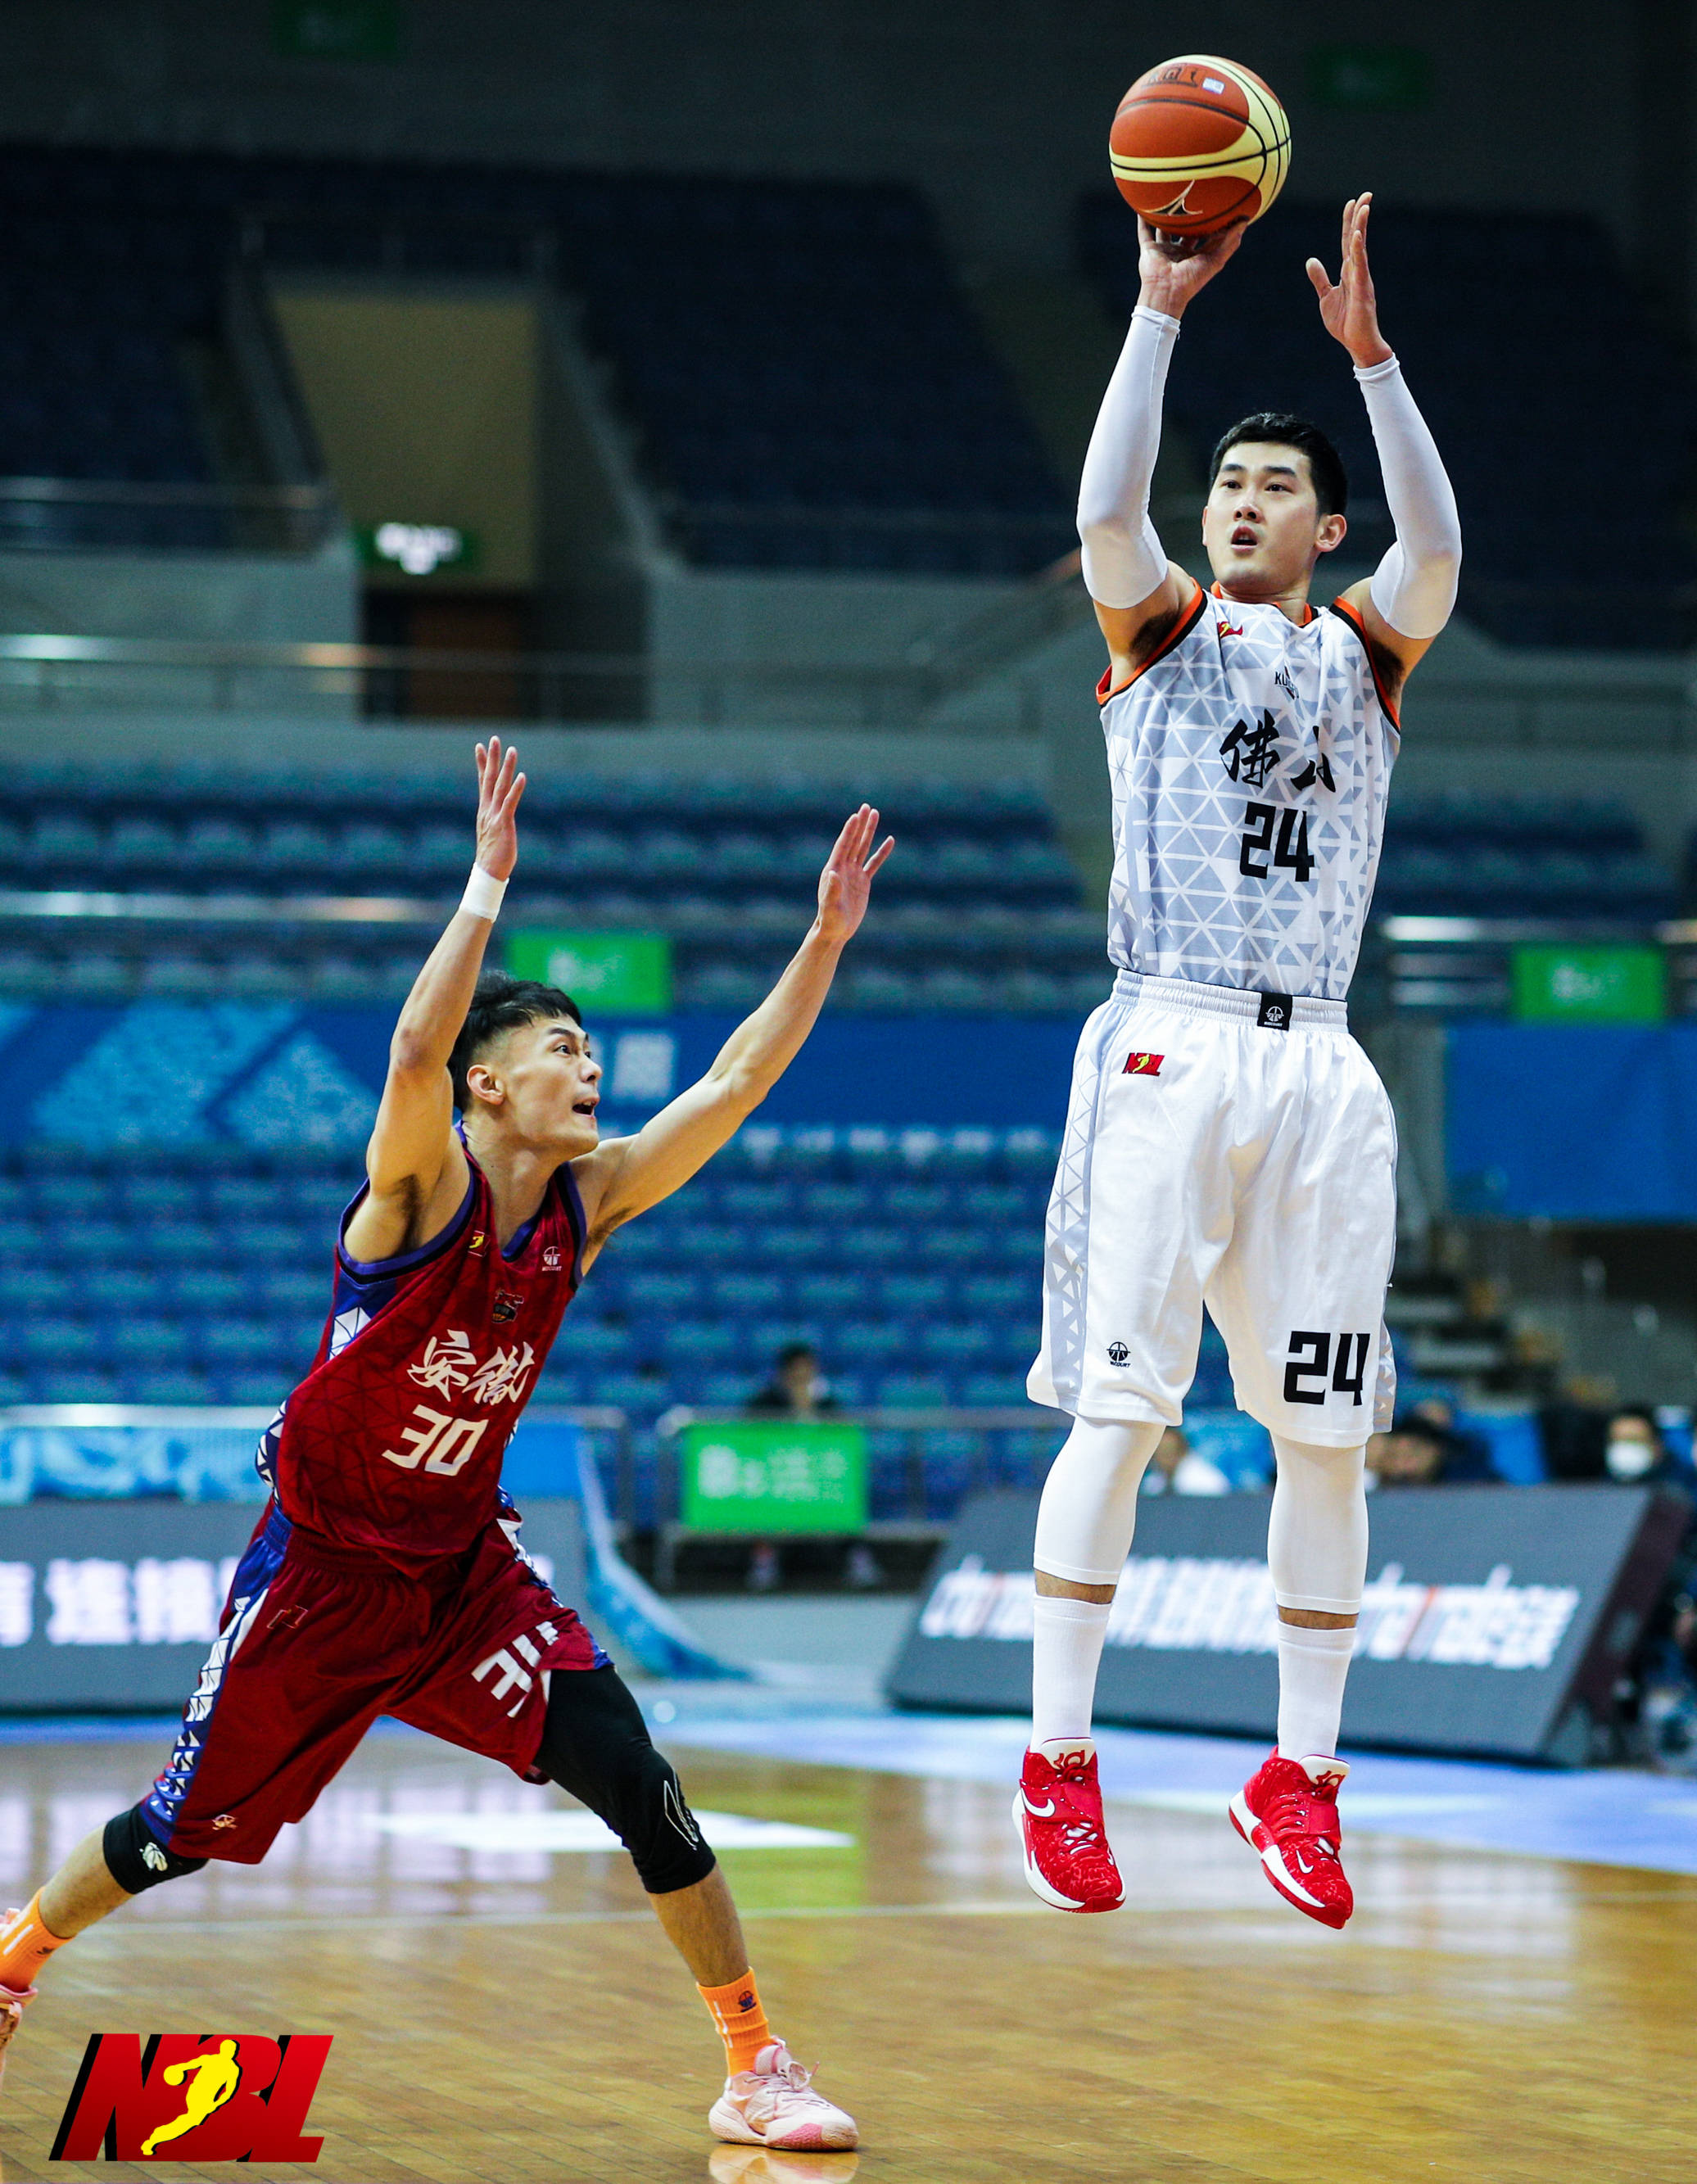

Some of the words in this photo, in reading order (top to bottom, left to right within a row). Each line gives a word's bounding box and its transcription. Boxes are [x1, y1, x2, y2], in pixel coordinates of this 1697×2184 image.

[1239, 802, 1315, 882] 24
[407, 1329, 535, 1406] 安徽
[1283, 1331, 1370, 1406] 24
[382, 1404, 489, 1476] 30
